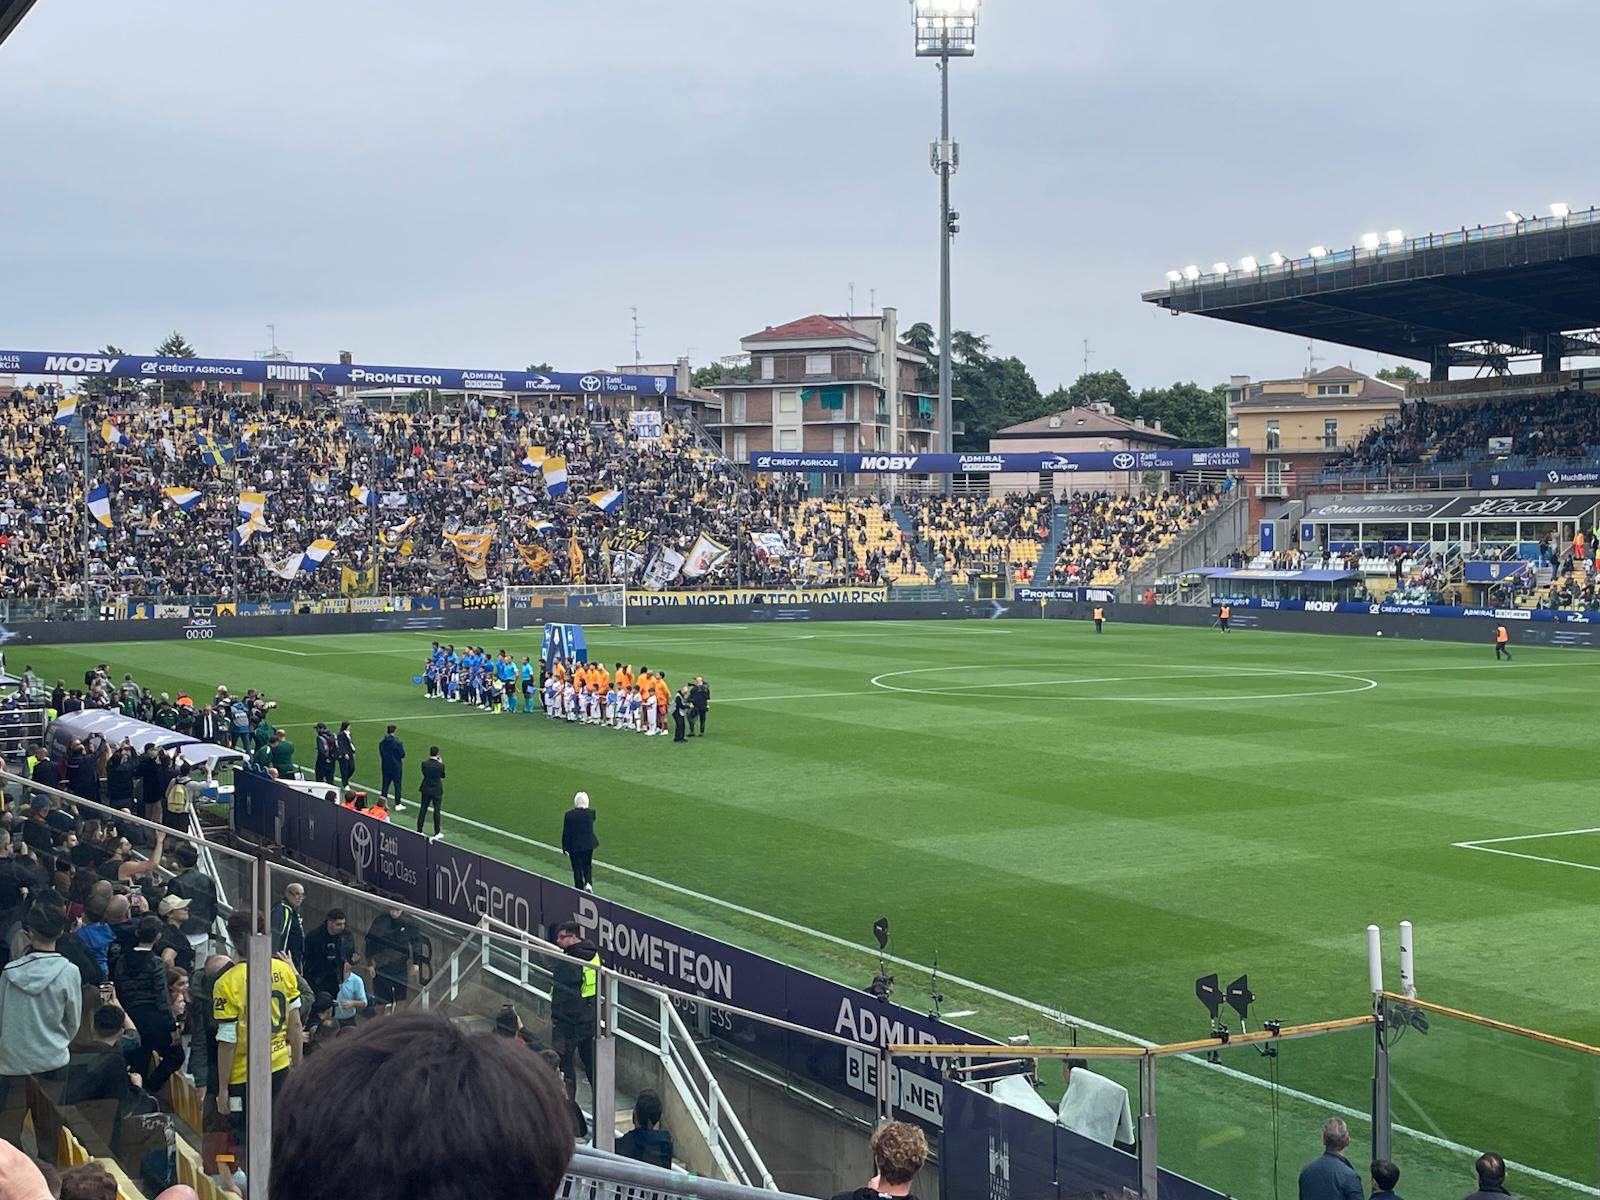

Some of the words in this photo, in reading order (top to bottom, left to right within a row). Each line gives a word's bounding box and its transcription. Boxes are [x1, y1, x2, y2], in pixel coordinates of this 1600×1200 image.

[45, 356, 119, 373] MOBY
[159, 365, 194, 373] CRÉDIT
[195, 367, 243, 375] AGRICOLE
[267, 365, 309, 380] PUMA
[347, 369, 442, 385] PROMETEON
[461, 371, 507, 381] ADMIRAL
[959, 455, 1005, 463] ADMIRAL
[1221, 452, 1240, 460] SALES
[771, 458, 799, 466] CRÉDIT
[800, 459, 839, 467] AGRICOLE
[860, 457, 918, 470] MOBY
[1140, 460, 1153, 468] Top
[1154, 459, 1174, 467] Class
[1560, 473, 1599, 481] MuchBetter
[1305, 601, 1338, 612] MOBY
[1463, 609, 1495, 617] ADMIRAL
[186, 629, 214, 639] 00:00
[380, 832, 399, 854] Zatti
[380, 853, 396, 876] Top
[394, 859, 417, 885] Class
[573, 897, 732, 999] PROMETEON
